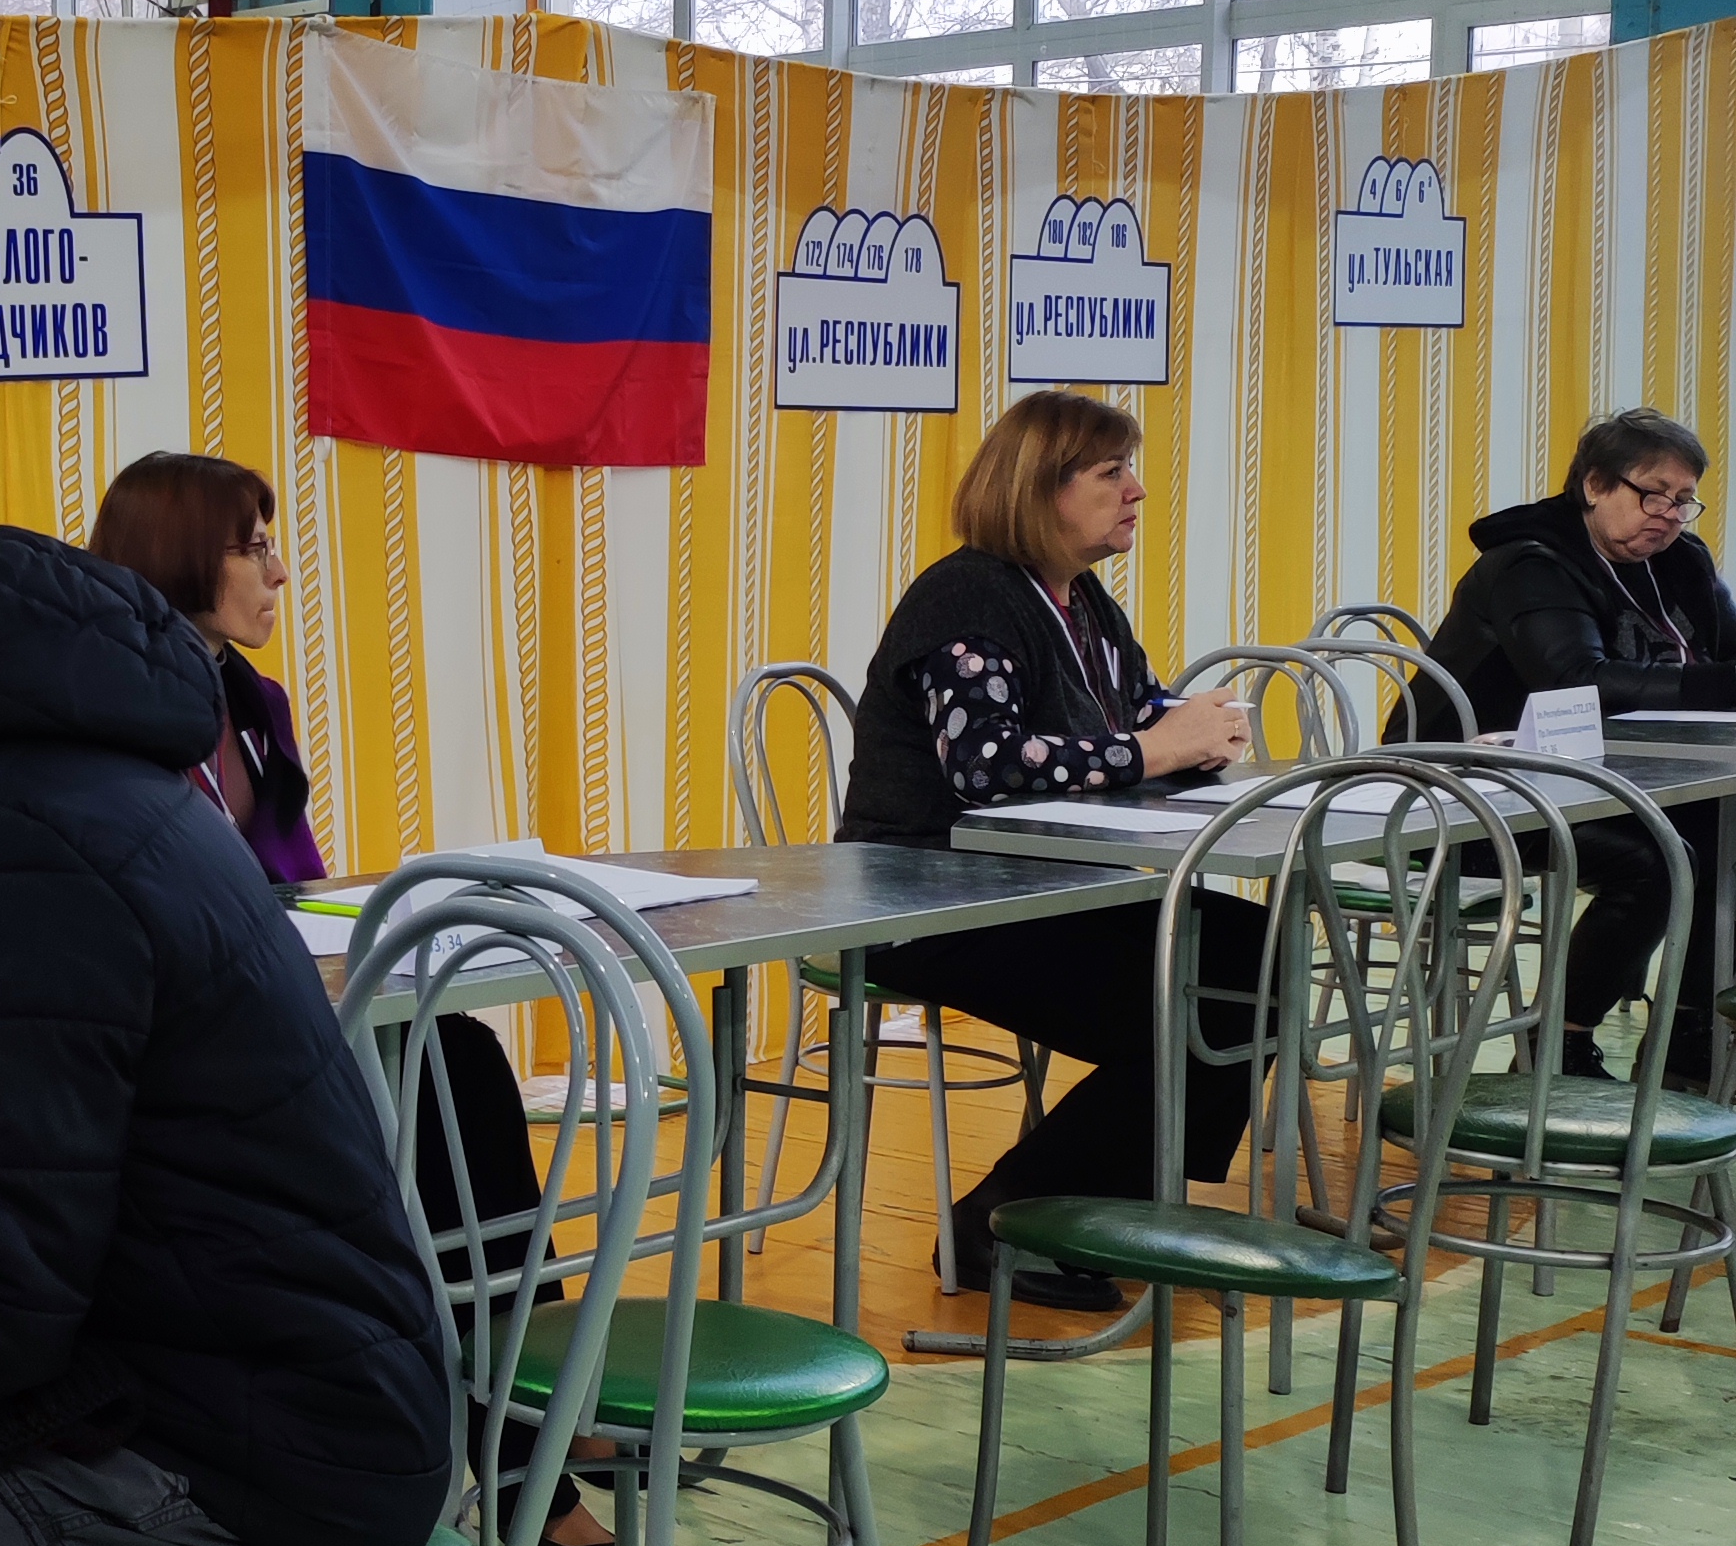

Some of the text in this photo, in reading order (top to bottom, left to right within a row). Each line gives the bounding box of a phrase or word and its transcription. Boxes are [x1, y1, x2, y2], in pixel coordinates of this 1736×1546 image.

[12, 163, 39, 197] 36
[1369, 178, 1377, 201] 4
[1395, 179, 1403, 202] 6
[1047, 218, 1128, 249] 180 182 186
[805, 239, 922, 274] 172 174 176 178
[1348, 247, 1453, 294] ул.ТУЛЬСКАЯ
[1015, 294, 1156, 346] ул.РЕСПУБЛИКИ
[787, 319, 948, 374] ул.РЕСПУБЛИКИ
[447, 933, 463, 952] 34
